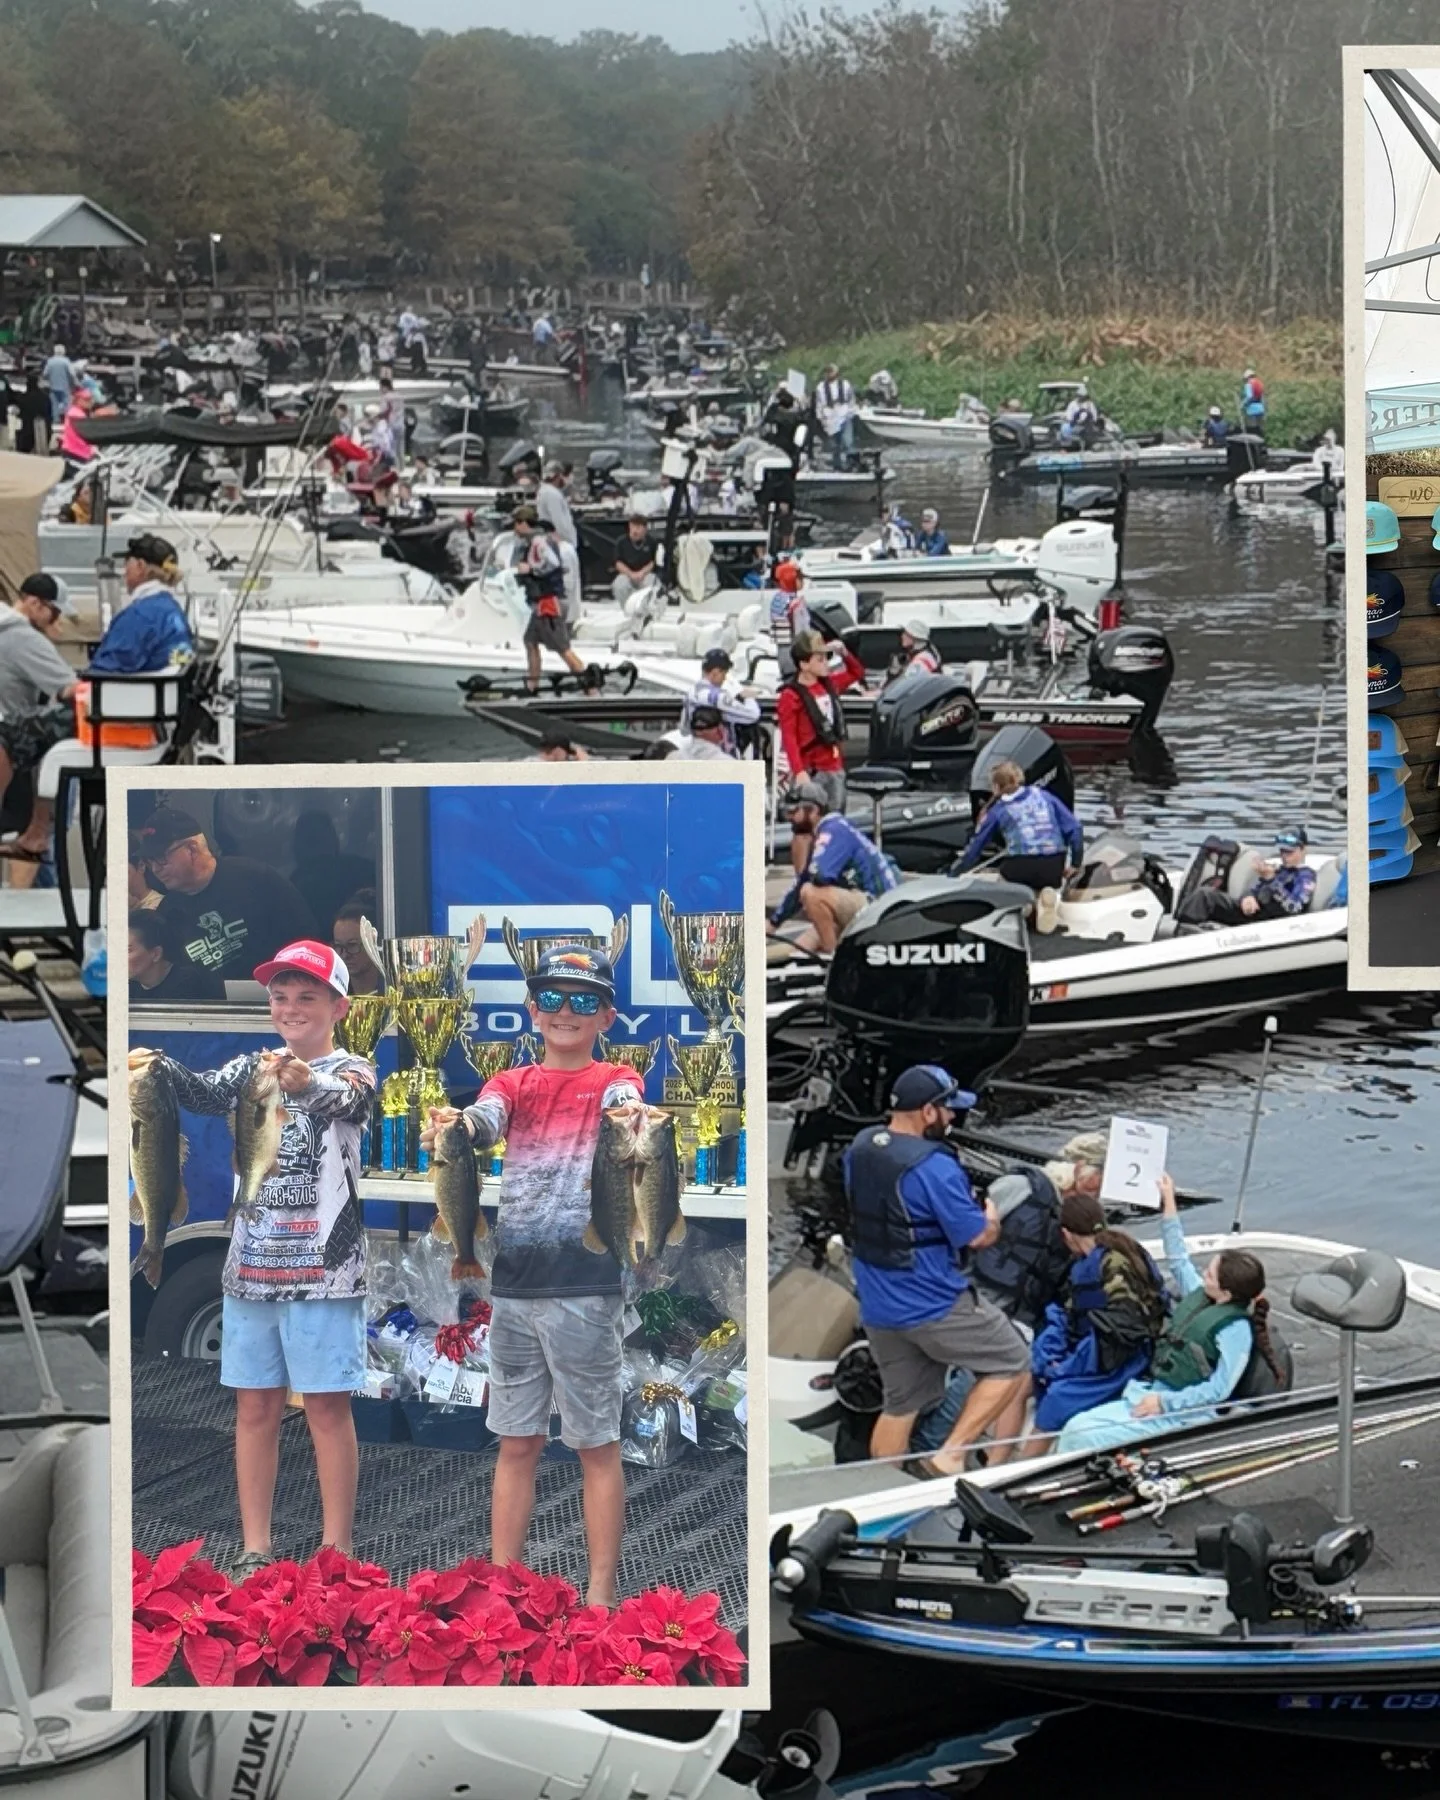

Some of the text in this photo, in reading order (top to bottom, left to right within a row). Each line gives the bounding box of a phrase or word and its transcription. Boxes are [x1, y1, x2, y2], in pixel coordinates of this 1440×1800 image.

[992, 711, 1131, 724] BASS TRACKER
[185, 918, 248, 959] BLC
[866, 942, 986, 966] SUZUKI
[547, 964, 597, 979] Waterman
[460, 1012, 651, 1035] BOY
[709, 1081, 735, 1090] CHOOL
[665, 1092, 736, 1102] CHAPION
[1124, 1162, 1142, 1187] 2
[1330, 1694, 1440, 1709] FL 09
